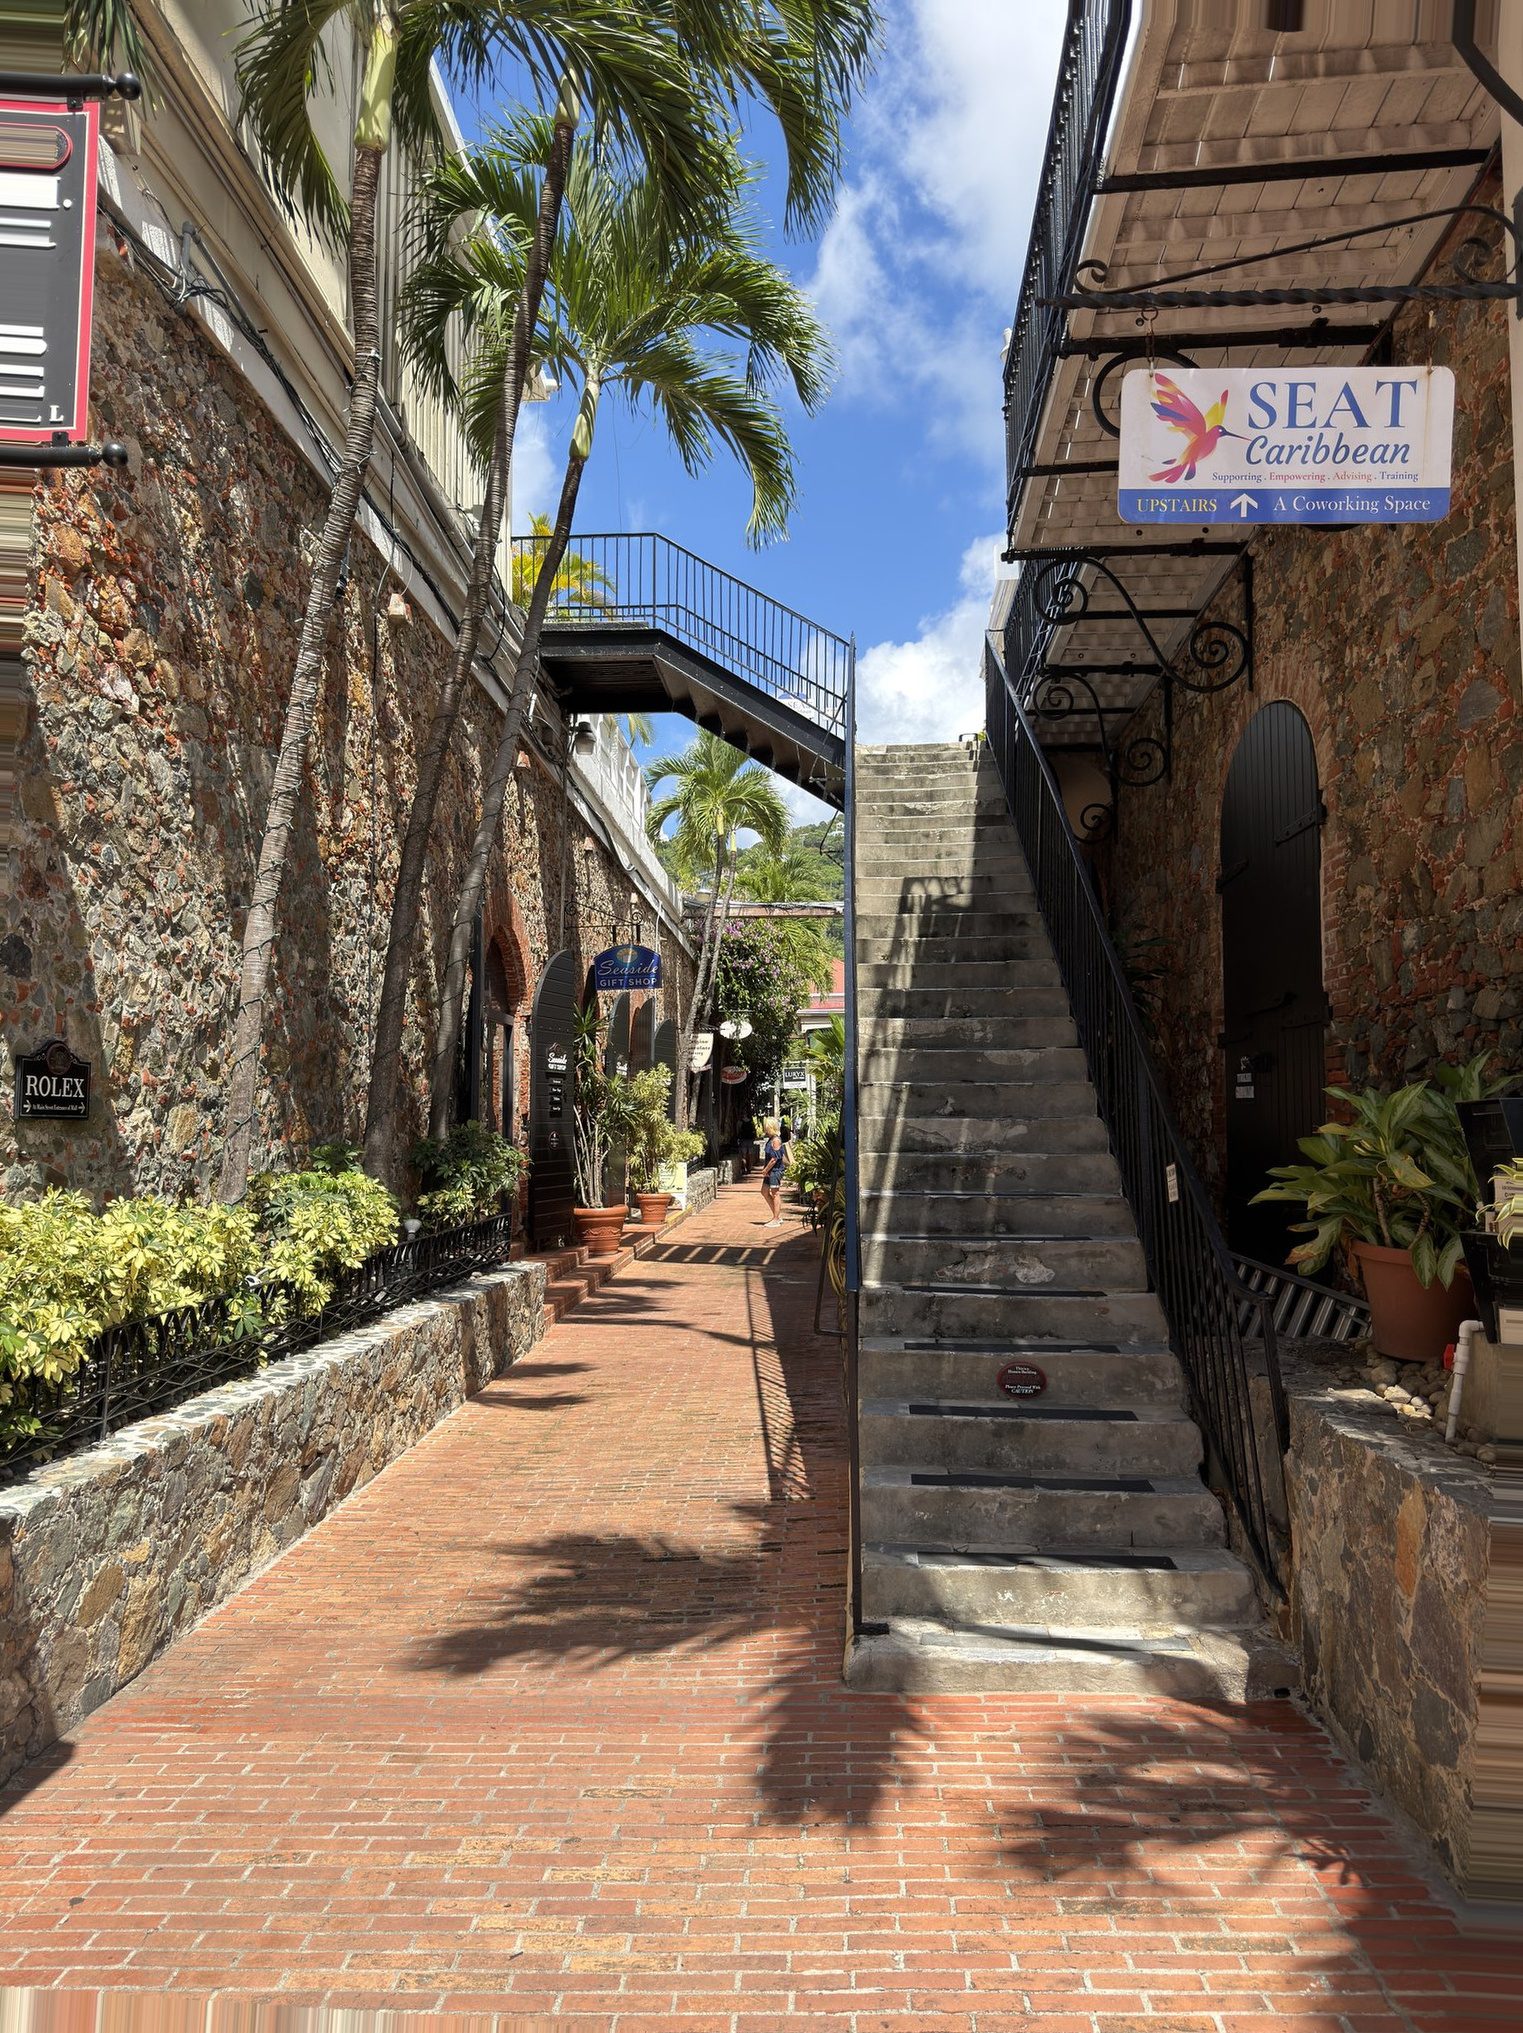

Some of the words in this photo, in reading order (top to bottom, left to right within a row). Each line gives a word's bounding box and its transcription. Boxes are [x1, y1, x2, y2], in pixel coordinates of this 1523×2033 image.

[1247, 380, 1418, 429] SEAT
[1245, 432, 1410, 465] Caribbean
[1212, 472, 1262, 483] Supporting
[1269, 472, 1326, 483] Empowering
[1332, 472, 1372, 482] Advising
[1379, 471, 1419, 482] Training
[1137, 498, 1217, 512] UPSTAIRS
[1274, 496, 1287, 511] A
[1293, 495, 1380, 513] Coworking
[1384, 495, 1431, 514] Space
[598, 960, 659, 976] Seaside
[600, 979, 623, 987] GIFT
[629, 977, 657, 986] SHOP
[25, 1075, 85, 1098] ROLEX
